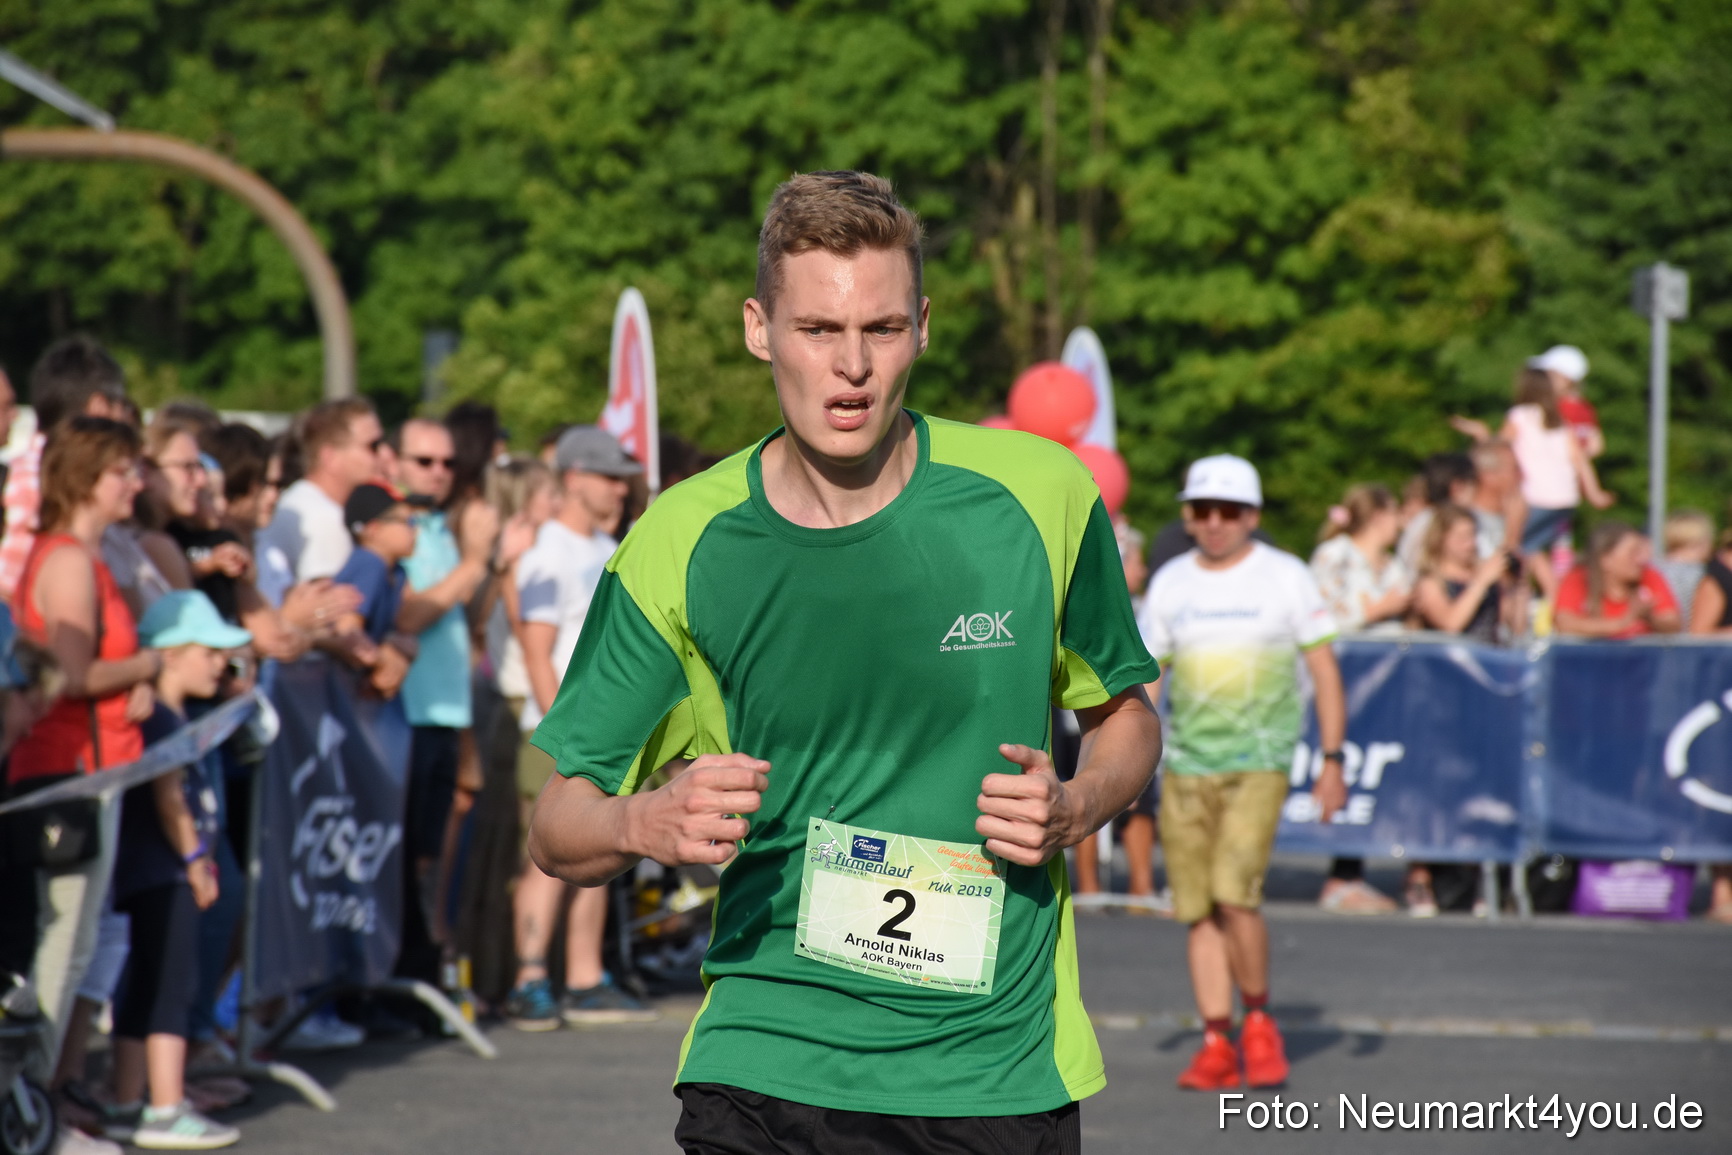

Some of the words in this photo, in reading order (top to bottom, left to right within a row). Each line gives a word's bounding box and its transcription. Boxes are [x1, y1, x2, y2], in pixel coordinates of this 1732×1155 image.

[941, 610, 1014, 644] AOK
[940, 644, 952, 652] Die
[835, 852, 915, 879] firmenlauf
[928, 881, 953, 893] run
[957, 884, 993, 897] 2019
[877, 888, 916, 941] 2
[844, 932, 894, 954] Arnold
[899, 943, 945, 963] Niklas
[861, 951, 884, 964] AOK
[887, 957, 923, 972] Bayern
